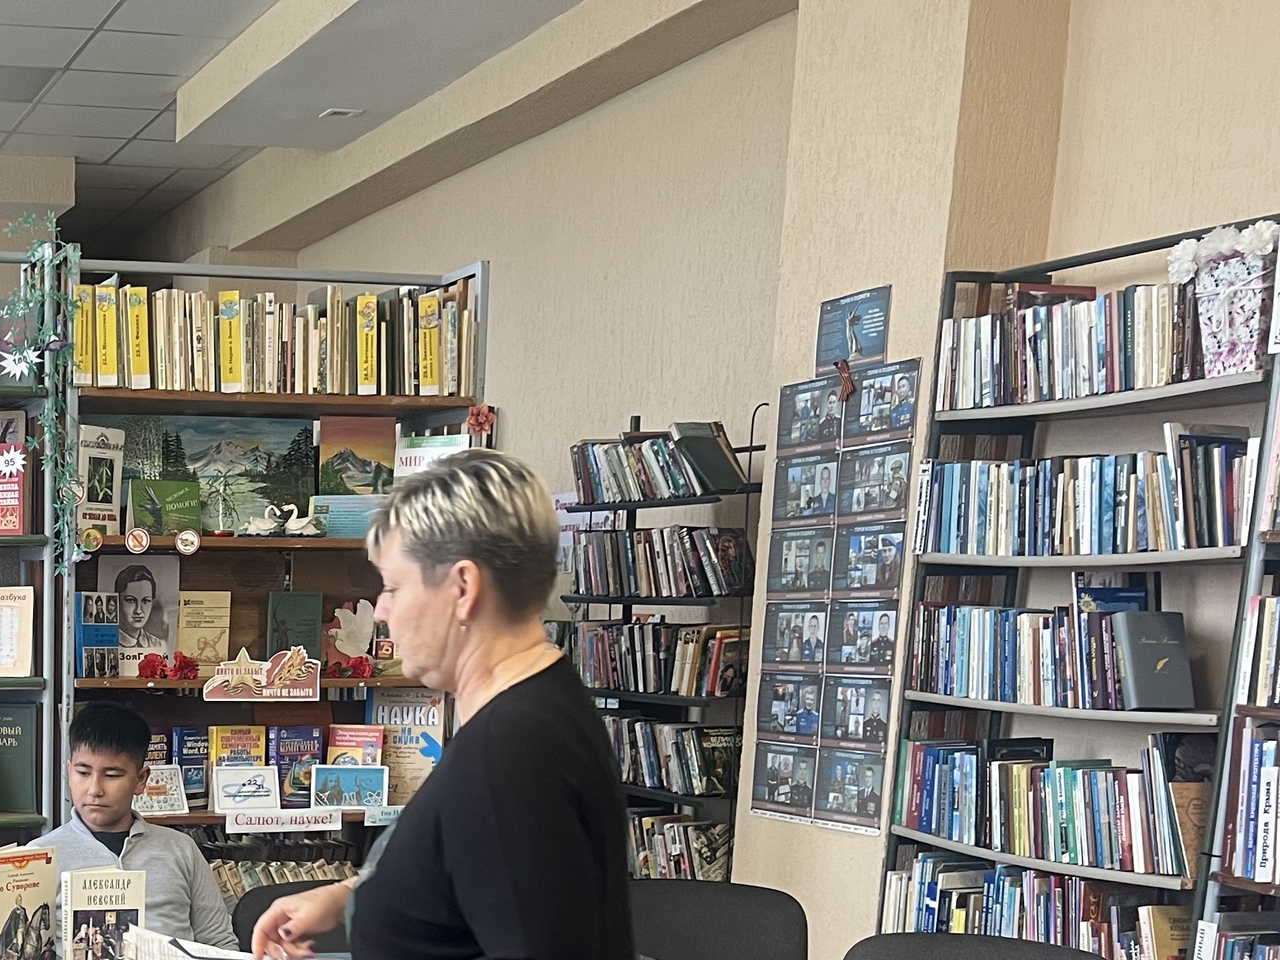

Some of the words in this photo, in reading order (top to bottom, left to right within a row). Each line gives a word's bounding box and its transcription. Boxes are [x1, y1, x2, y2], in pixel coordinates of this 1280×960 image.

[4, 458, 15, 467] 95
[399, 456, 424, 467] МИР
[166, 500, 198, 511] ПОМОГИ!
[0, 593, 28, 603] азбука
[262, 688, 280, 697] НИЧТО
[282, 688, 289, 696] НЕ
[289, 688, 313, 696] ЗАБЫТО
[377, 705, 439, 726] НАУКА
[279, 744, 319, 752] КОМПЬЮТЕР
[1262, 781, 1271, 815] Крыма
[233, 811, 286, 828] Салют,
[288, 811, 333, 827] науке!
[1259, 821, 1270, 868] Природа
[6, 881, 40, 893] Суворове
[82, 878, 132, 890] АЛЕКСАНДР
[87, 893, 126, 906] НЕВСКИЙ
